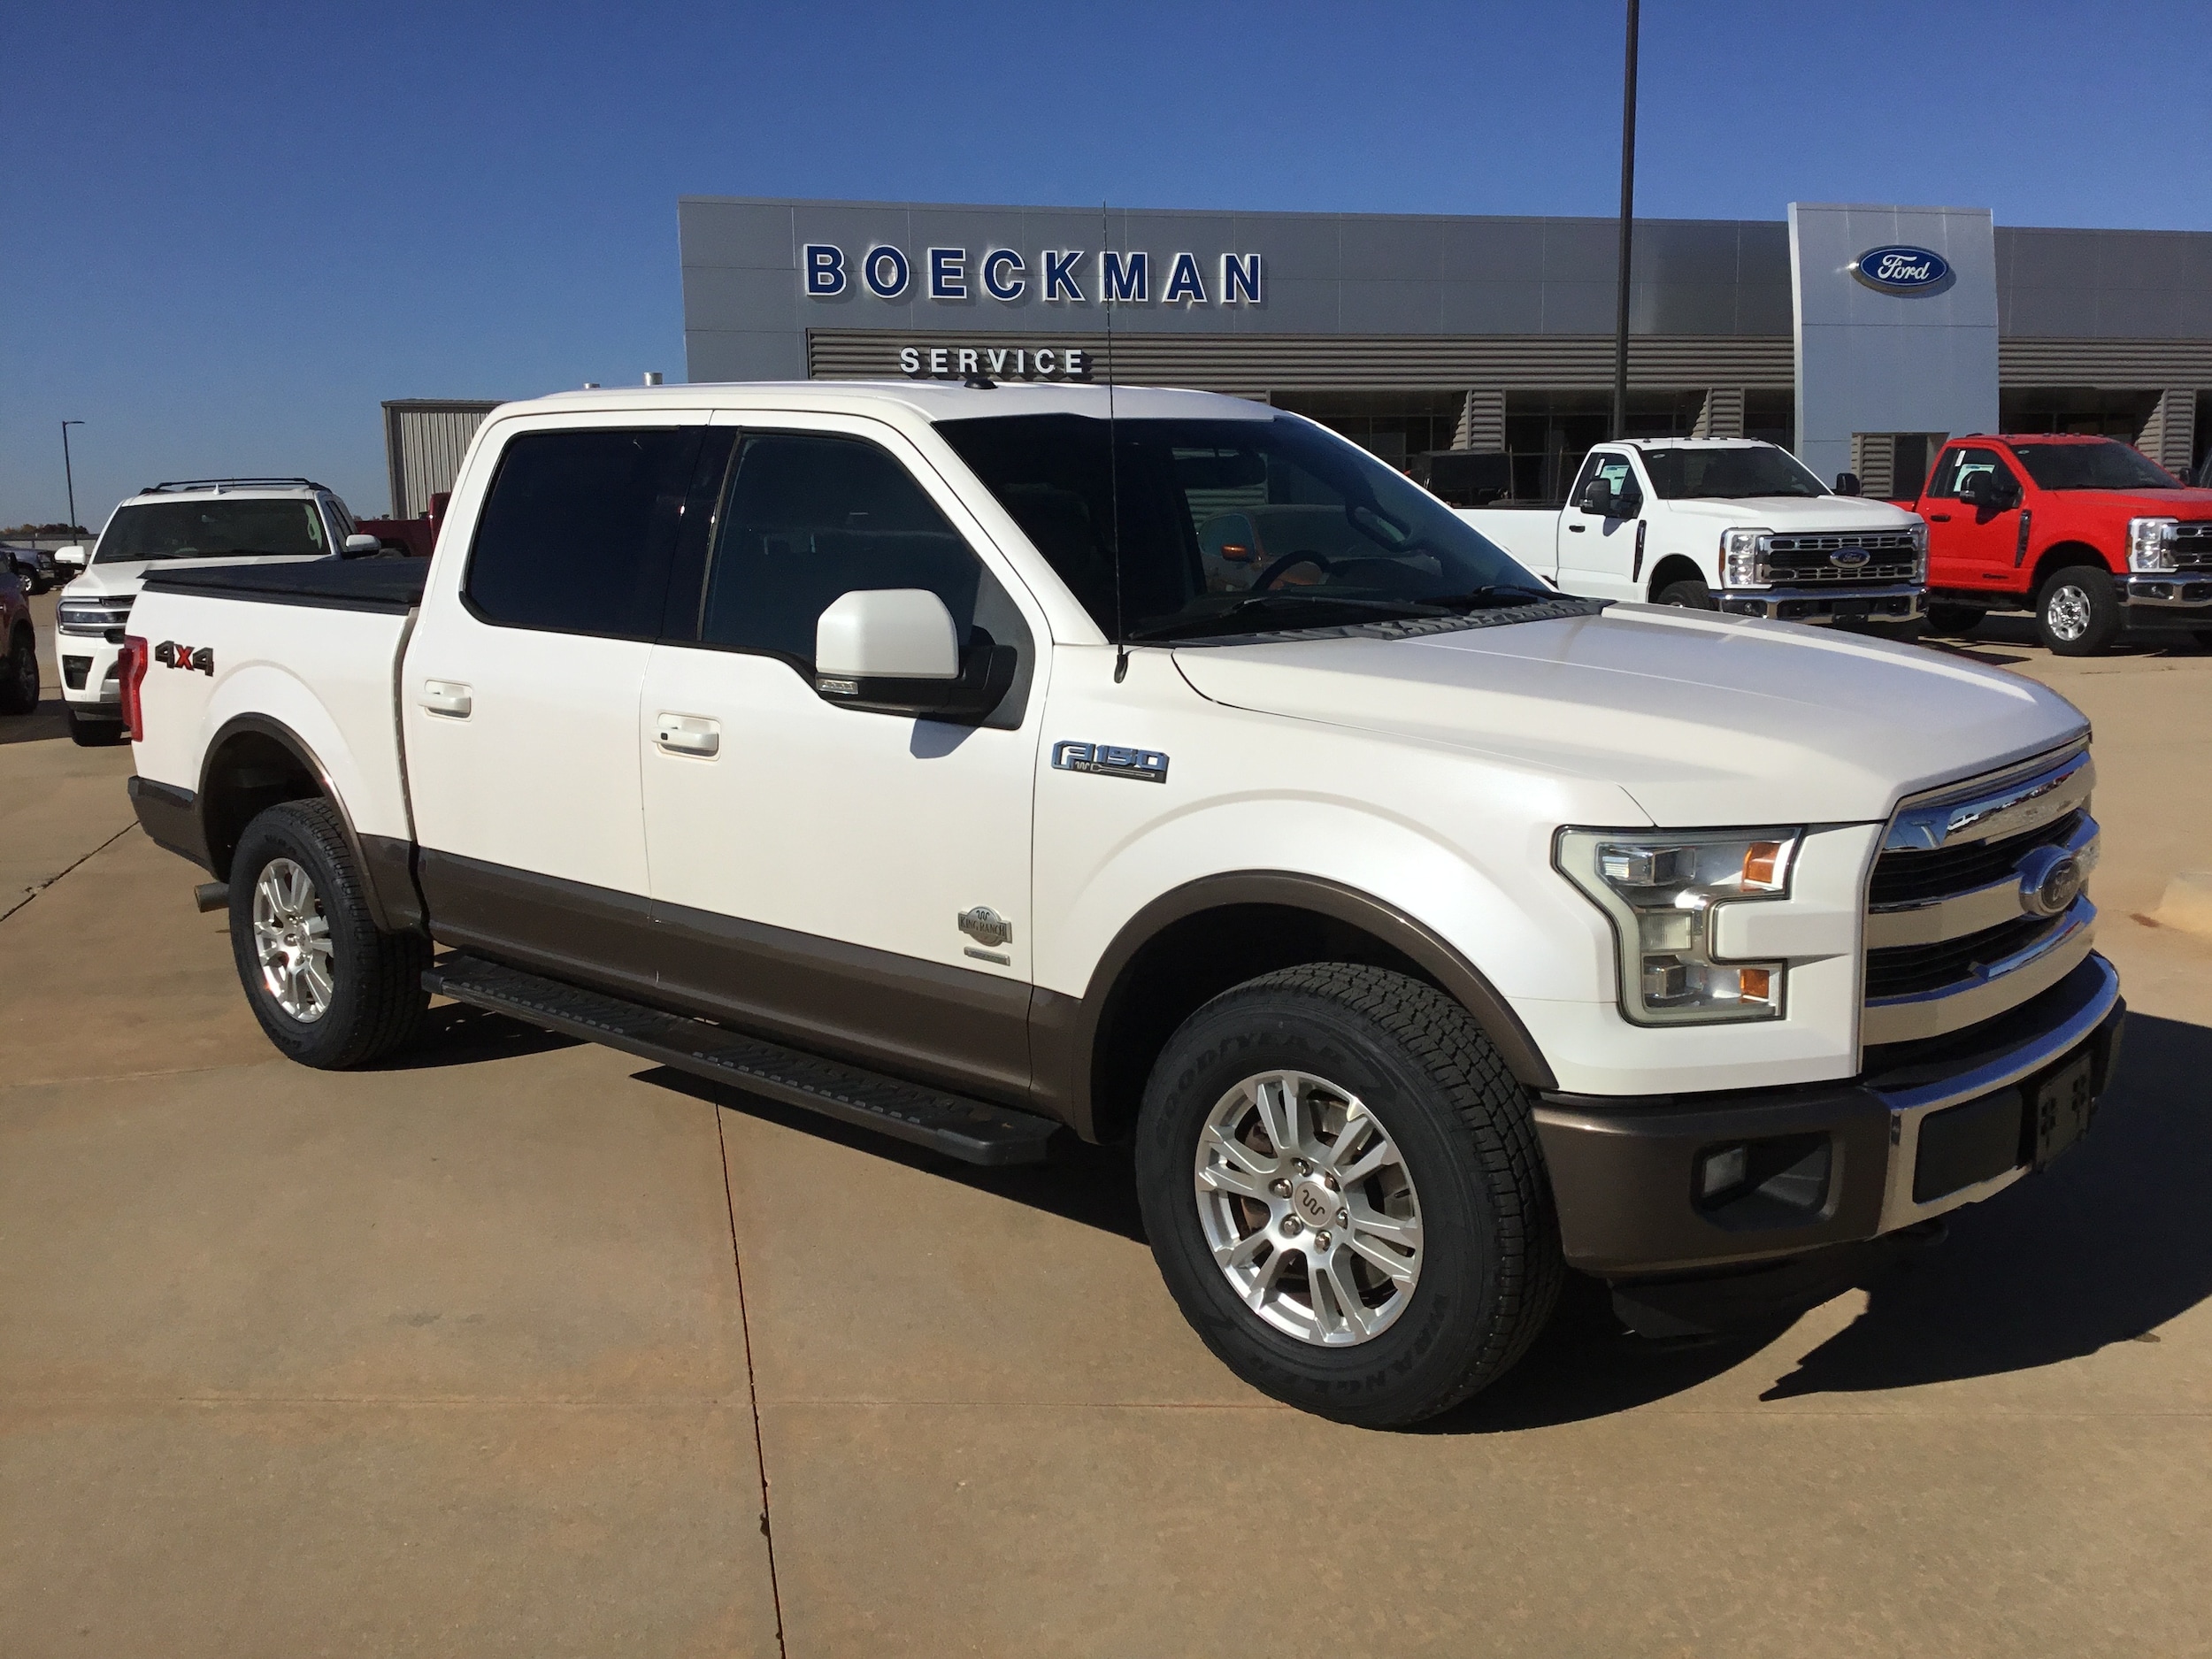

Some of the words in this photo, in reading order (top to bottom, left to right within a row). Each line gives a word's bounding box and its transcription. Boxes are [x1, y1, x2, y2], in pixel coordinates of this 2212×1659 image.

[803, 243, 1262, 303] BOECKMAN
[1878, 254, 1931, 280] Ford
[900, 346, 1083, 373] SERVICE
[960, 916, 979, 931] KING
[979, 920, 1006, 937] RANCH
